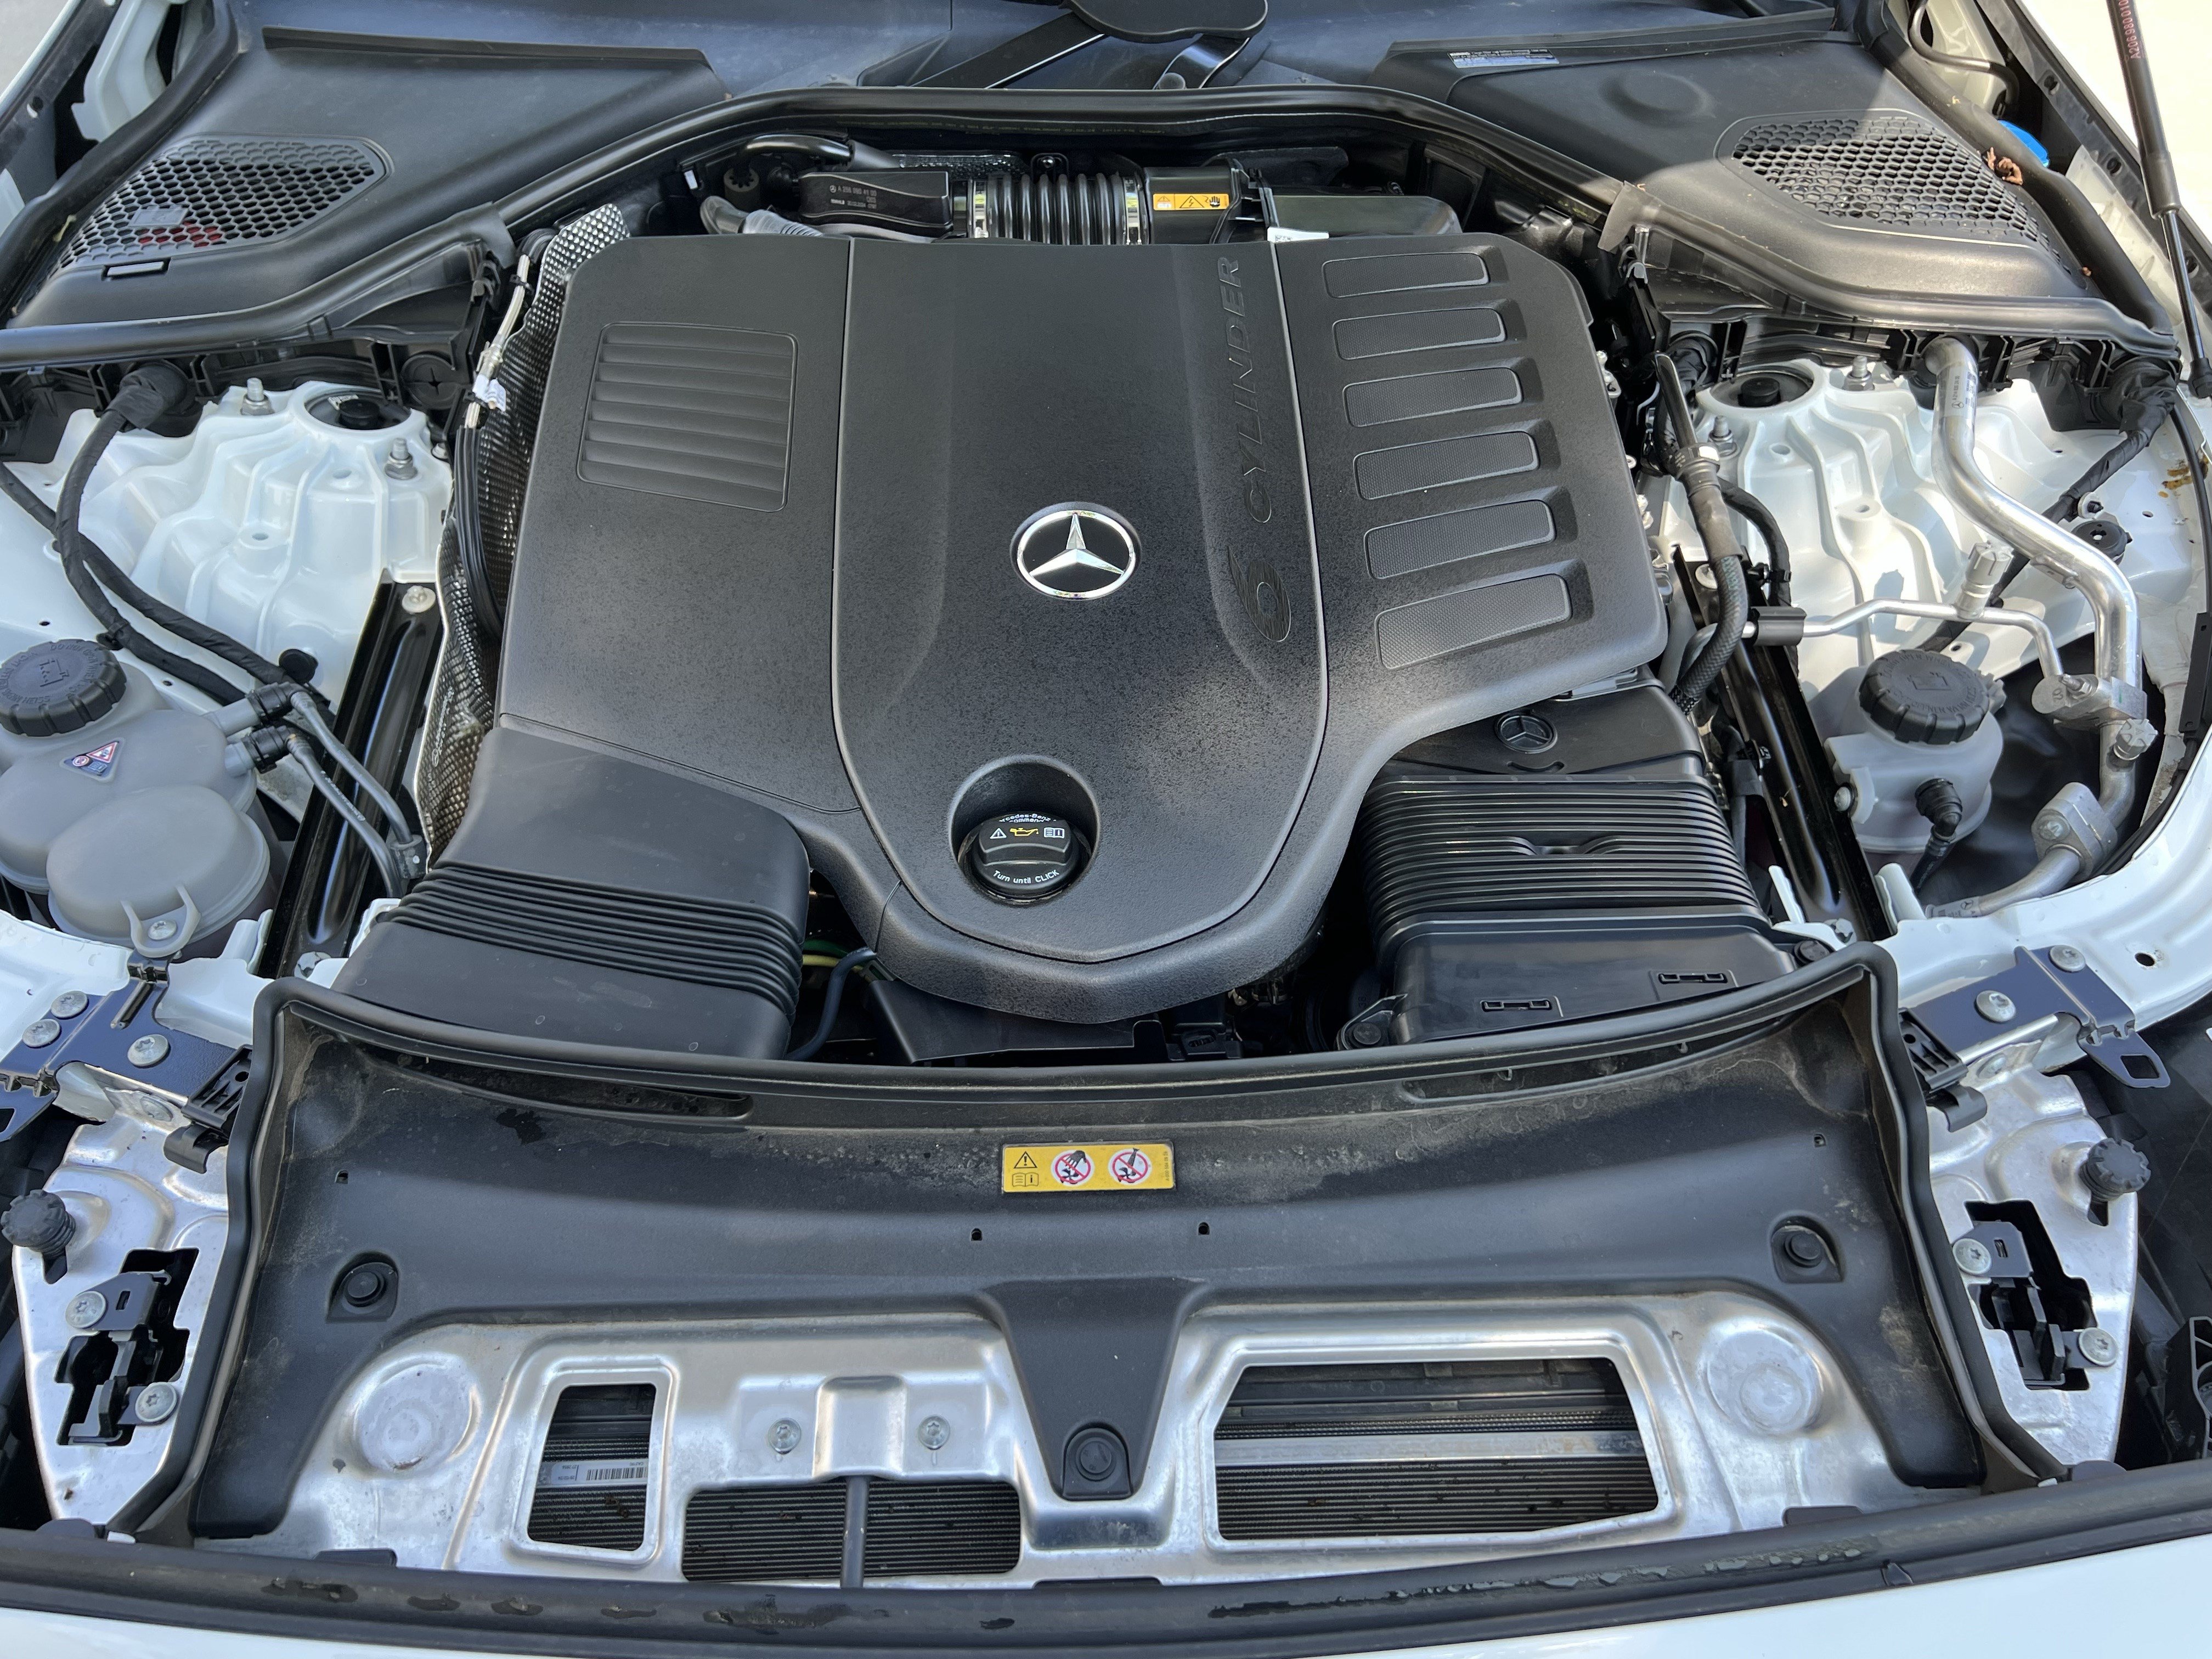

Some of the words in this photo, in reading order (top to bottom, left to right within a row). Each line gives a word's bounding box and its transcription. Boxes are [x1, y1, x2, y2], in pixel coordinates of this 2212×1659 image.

[1217, 256, 1272, 524] CYLINDER
[1227, 544, 1292, 643] 6
[993, 870, 1011, 882] Turn
[1035, 869, 1060, 883] CLICK
